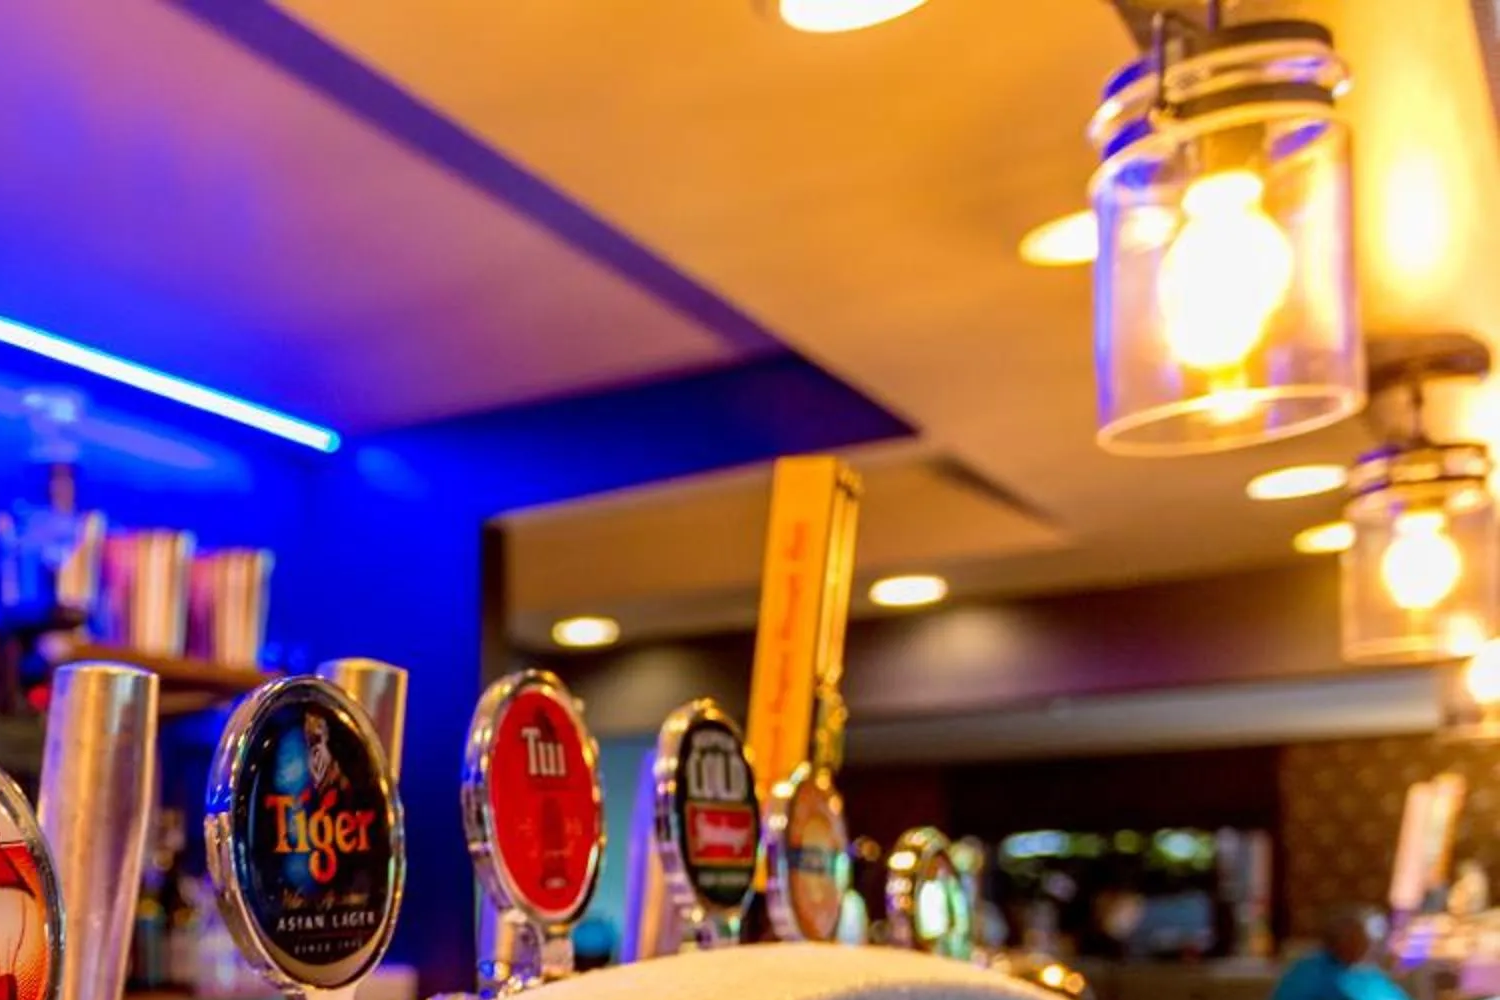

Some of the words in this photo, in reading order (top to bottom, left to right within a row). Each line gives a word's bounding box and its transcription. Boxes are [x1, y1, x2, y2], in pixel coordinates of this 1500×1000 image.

[521, 727, 567, 777] Tui
[264, 789, 375, 882] Tiger
[276, 915, 325, 932] ASIAN
[332, 911, 375, 929] LAGER
